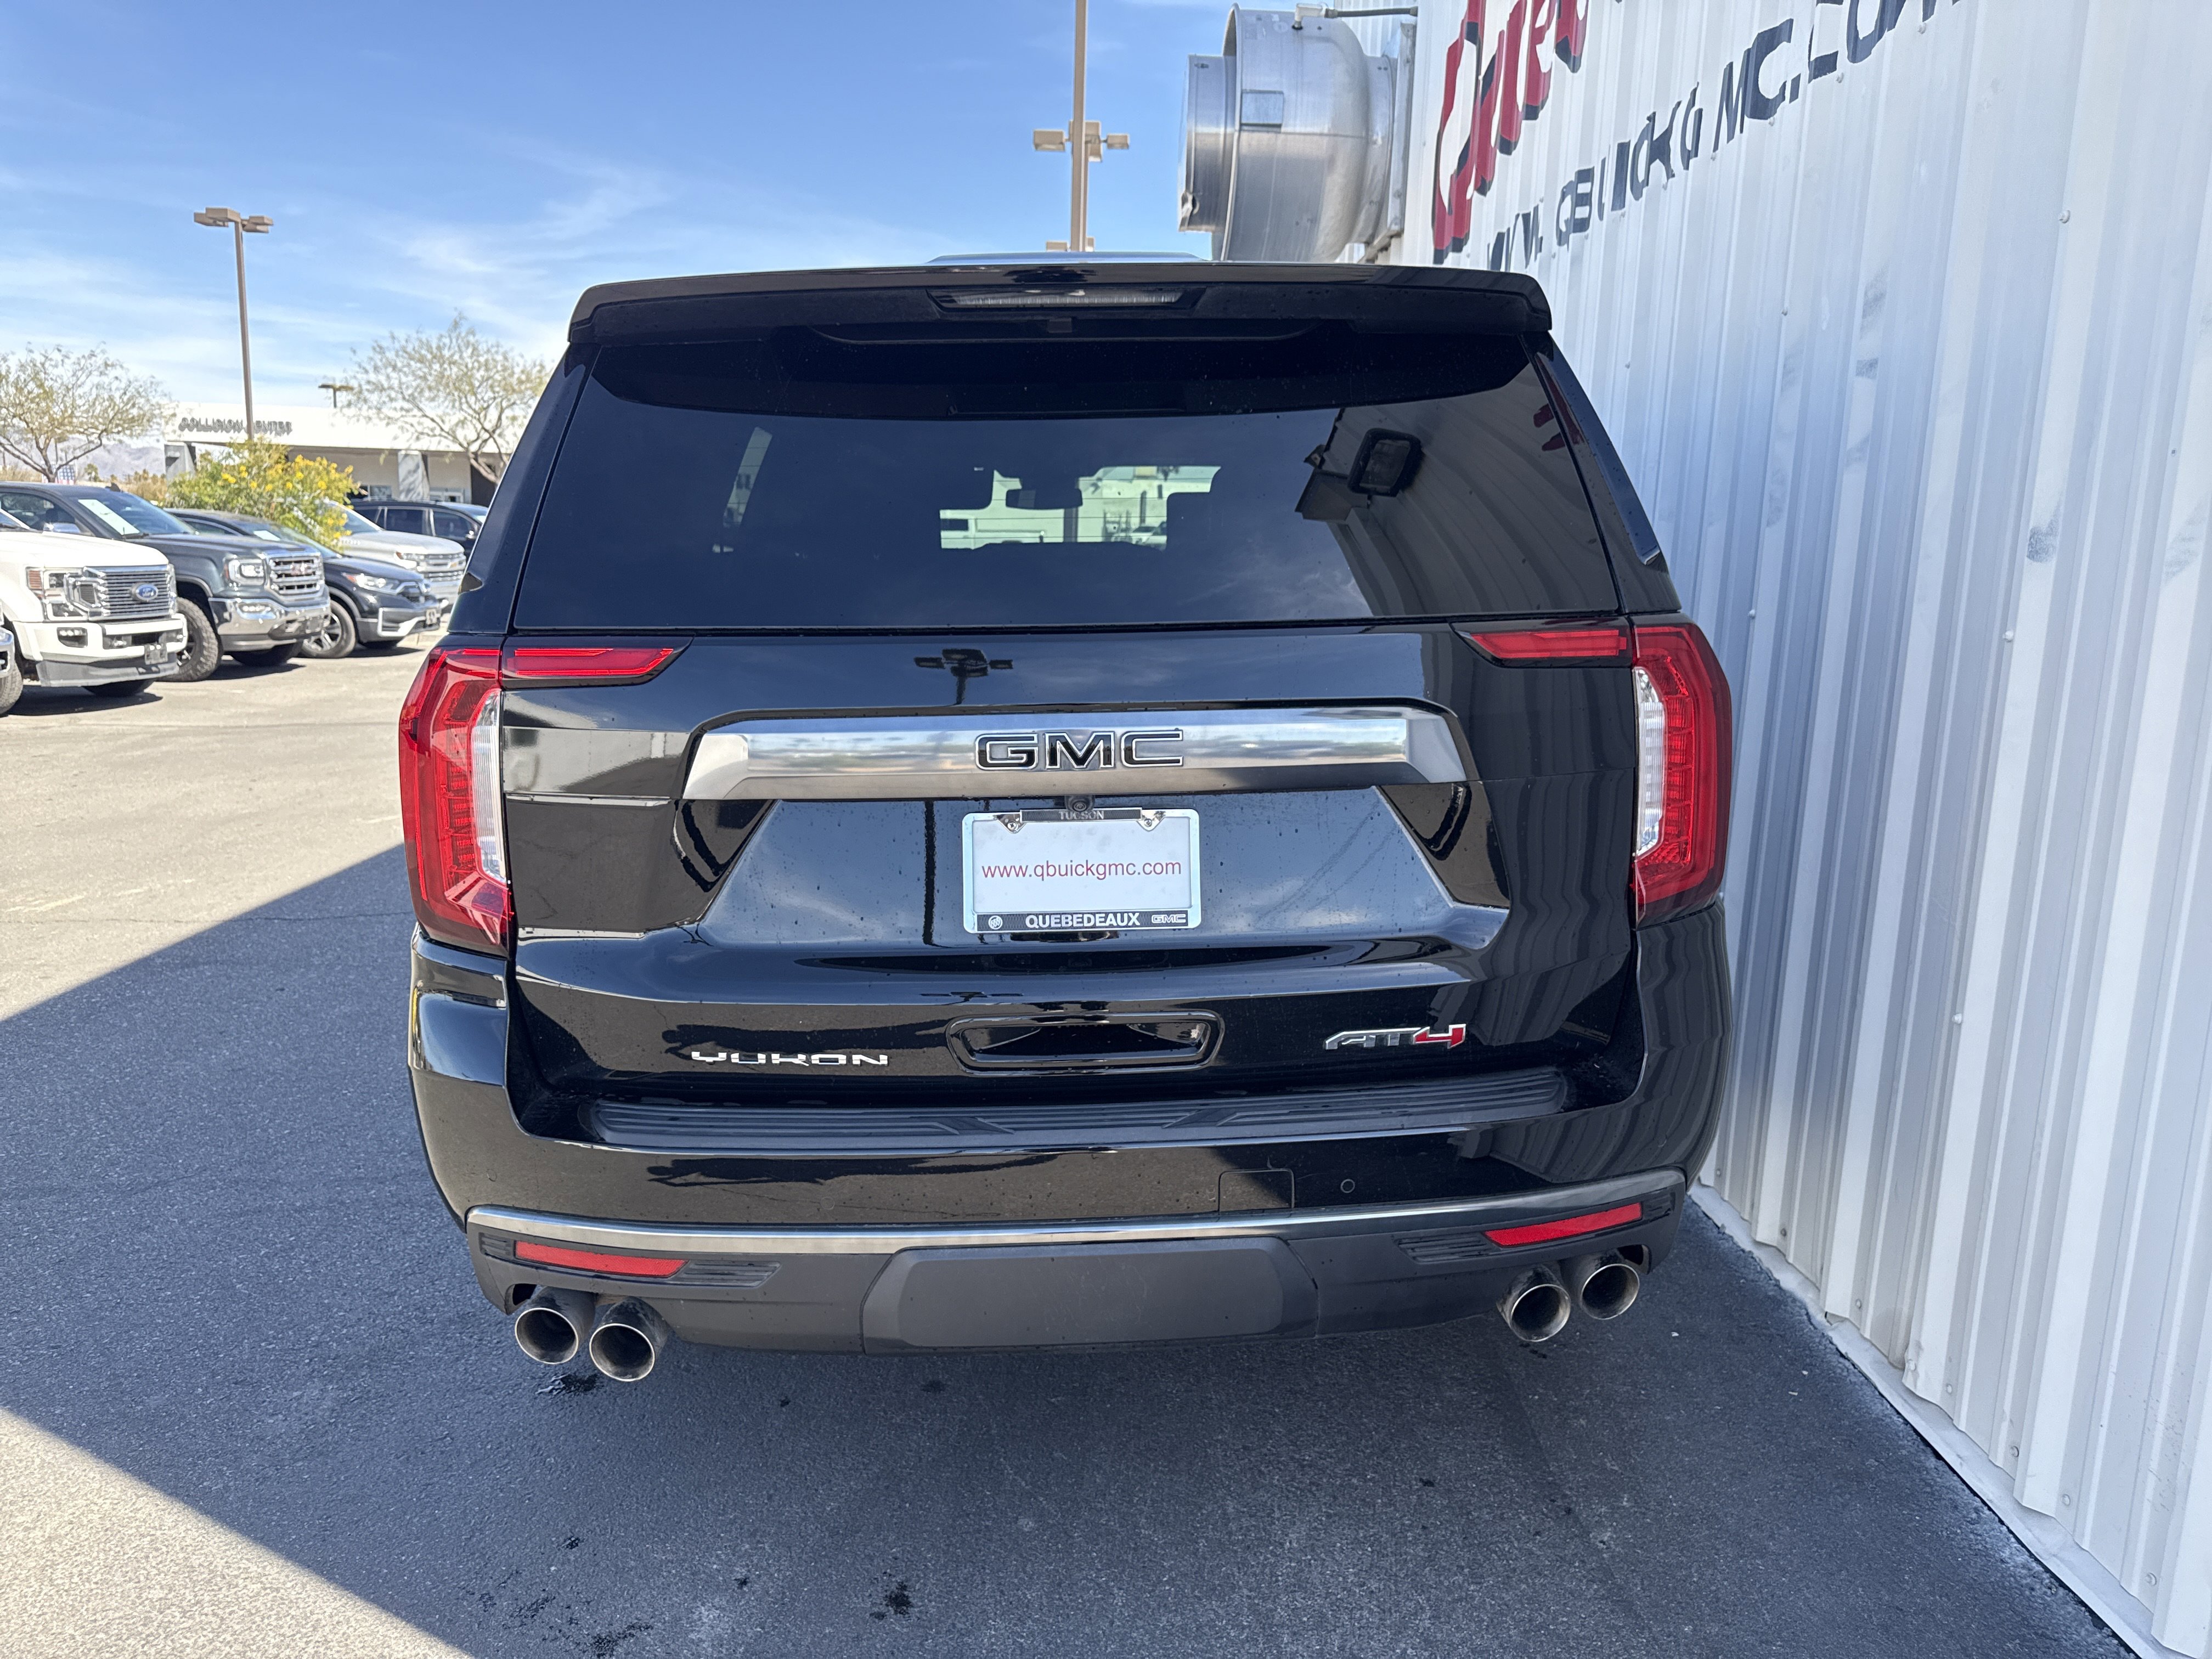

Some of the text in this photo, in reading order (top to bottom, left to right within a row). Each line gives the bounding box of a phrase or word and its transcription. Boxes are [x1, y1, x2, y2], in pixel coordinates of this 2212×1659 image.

[179, 417, 292, 435] COLLISION ENTER
[975, 730, 1183, 771] GMC
[1059, 810, 1104, 820] TUCSON
[982, 860, 1182, 881] www.qbuickgmc.com
[1025, 913, 1186, 928] QUEBEDEAUX GMC
[1323, 1024, 1466, 1050] AT4
[691, 1051, 888, 1066] YUKON
